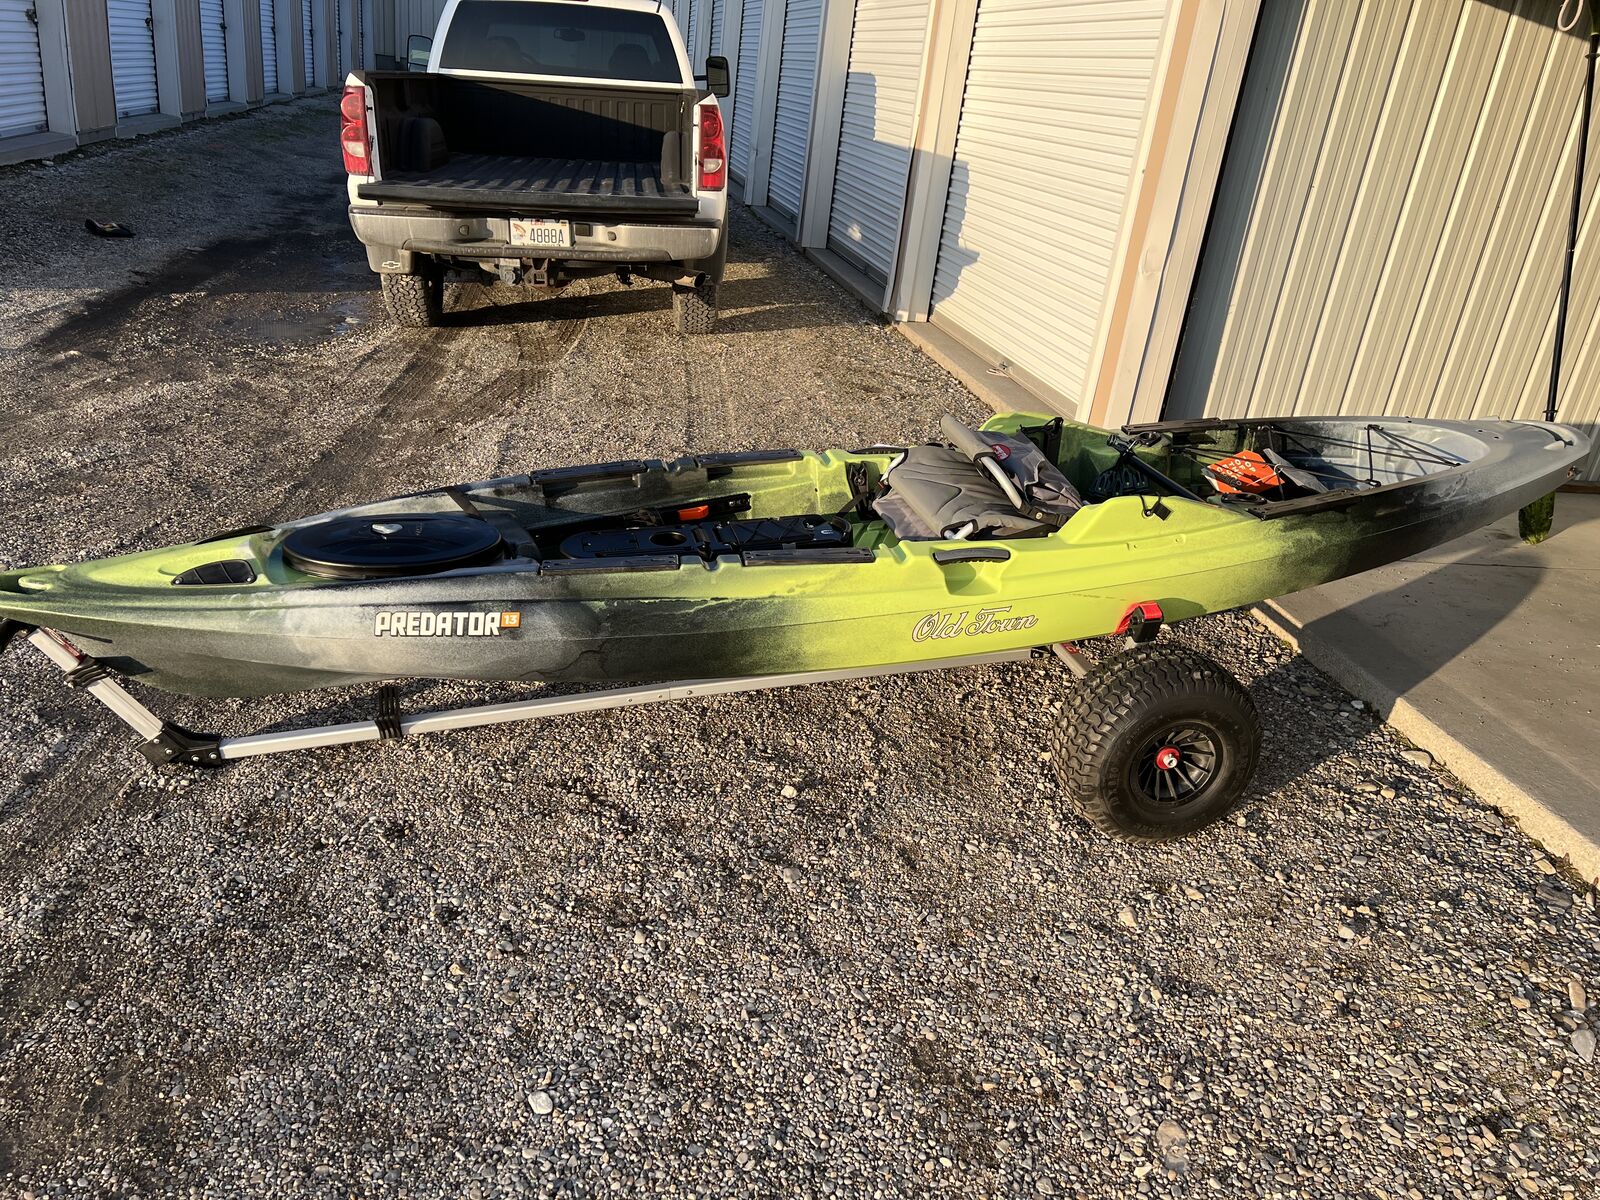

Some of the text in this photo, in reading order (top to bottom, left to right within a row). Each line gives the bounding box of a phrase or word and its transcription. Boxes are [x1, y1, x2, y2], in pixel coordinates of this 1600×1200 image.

[530, 228, 564, 244] 4888A
[374, 611, 518, 637] PREDATOR 13
[911, 605, 1038, 642] Old Town
